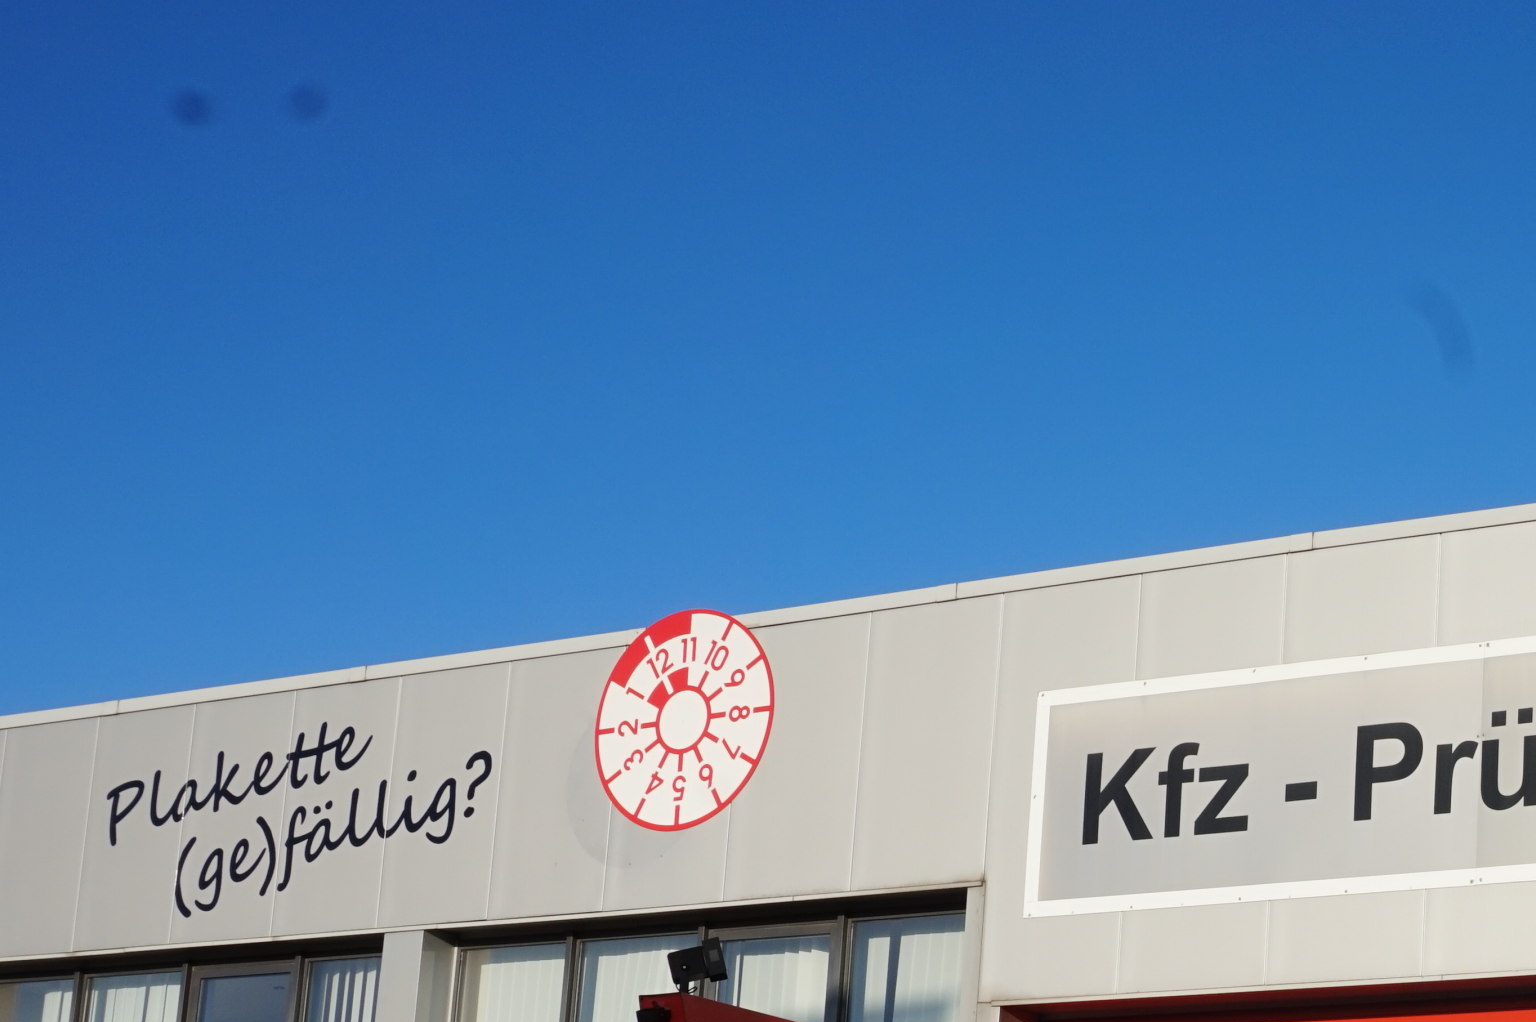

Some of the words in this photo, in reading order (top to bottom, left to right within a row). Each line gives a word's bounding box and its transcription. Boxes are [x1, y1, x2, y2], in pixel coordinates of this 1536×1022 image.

[681, 637, 697, 663] 11
[704, 640, 729, 671] 10
[646, 649, 674, 679] 12
[724, 669, 745, 687] 9
[626, 687, 645, 700] 1
[729, 706, 750, 722] 8
[617, 719, 639, 737] 2
[623, 749, 644, 771] 3
[722, 738, 741, 760] 7
[107, 721, 373, 846] Plakette
[645, 771, 664, 794] 4
[672, 775, 686, 801] 5
[699, 764, 713, 789] 6
[1082, 742, 1250, 845] Kfz
[1285, 781, 1318, 802] -
[174, 750, 493, 918] (ge)fällig?
